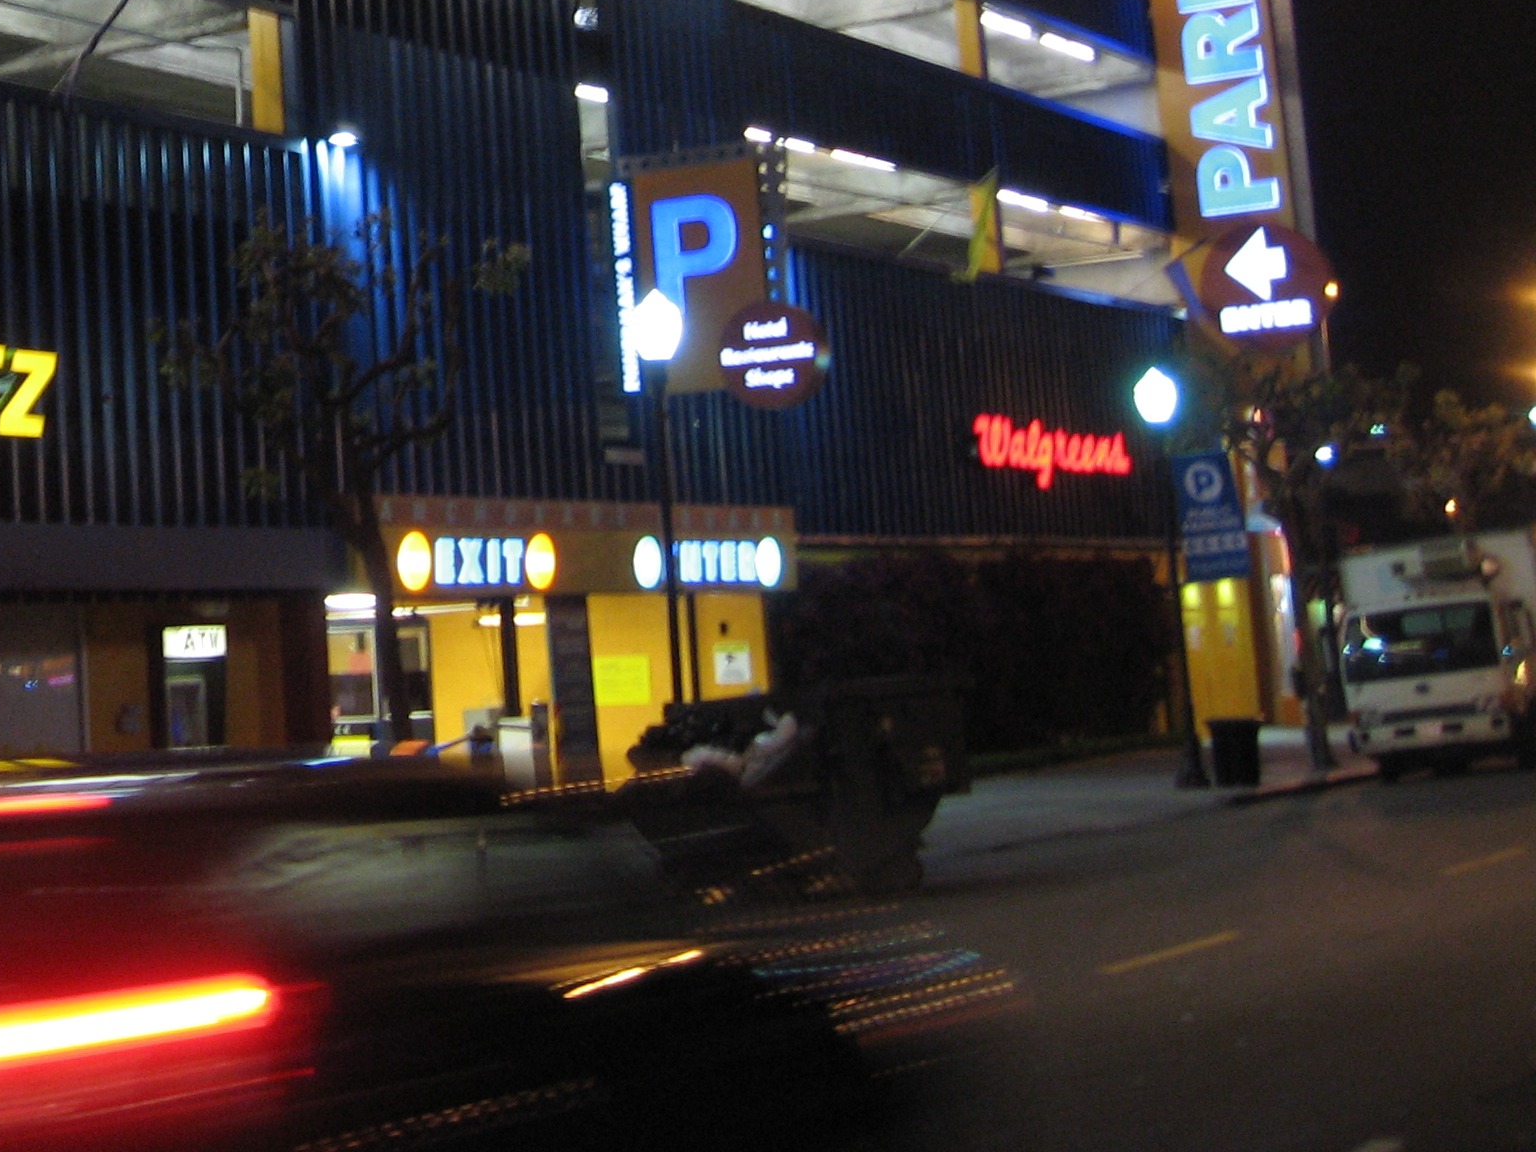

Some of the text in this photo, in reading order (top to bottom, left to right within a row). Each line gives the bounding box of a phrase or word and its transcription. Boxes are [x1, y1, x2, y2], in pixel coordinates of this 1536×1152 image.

[651, 194, 737, 320] P
[972, 413, 1133, 490] Walgreens
[434, 536, 525, 586] EXIT
[670, 539, 758, 584] NTER
